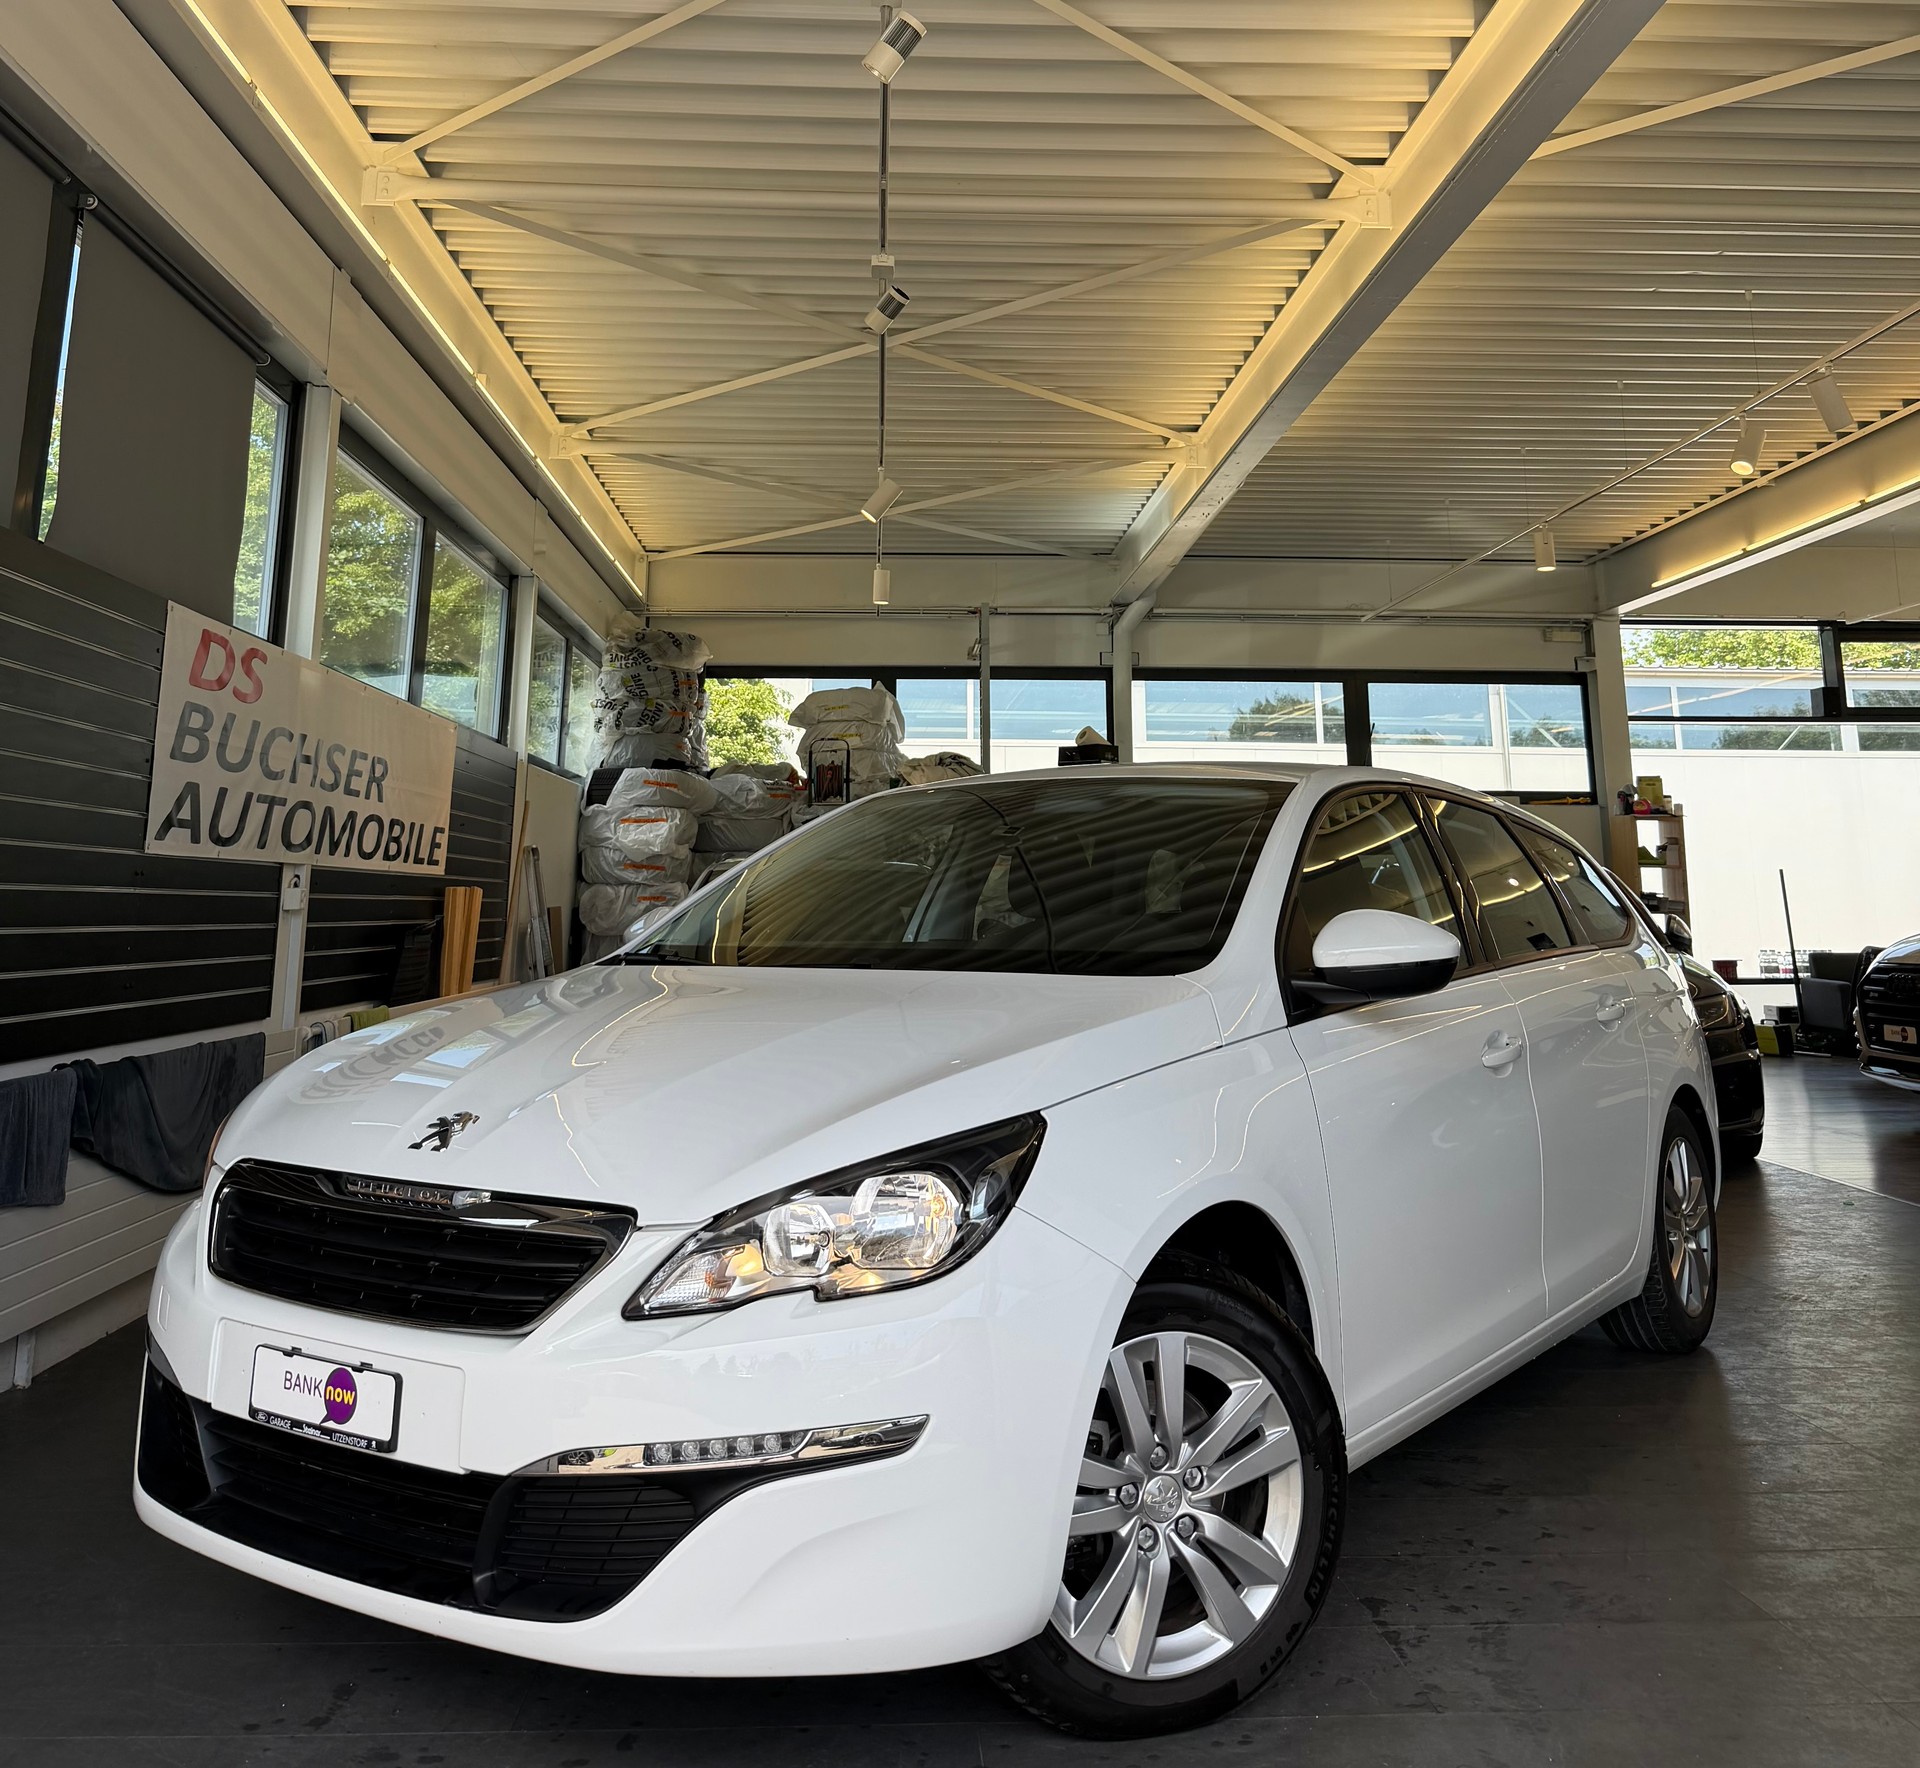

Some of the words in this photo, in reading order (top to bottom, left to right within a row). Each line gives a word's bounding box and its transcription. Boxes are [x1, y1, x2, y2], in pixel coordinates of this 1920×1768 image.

[188, 628, 268, 704] DS
[169, 700, 389, 803] BUCHSER
[154, 781, 446, 866] AUTOMOBILE
[357, 1180, 441, 1200] PEUGEOT
[283, 1370, 323, 1399] BANK
[326, 1385, 355, 1406] now
[269, 1415, 292, 1429] GARAGE
[332, 1432, 368, 1448] UTZENSTORF
